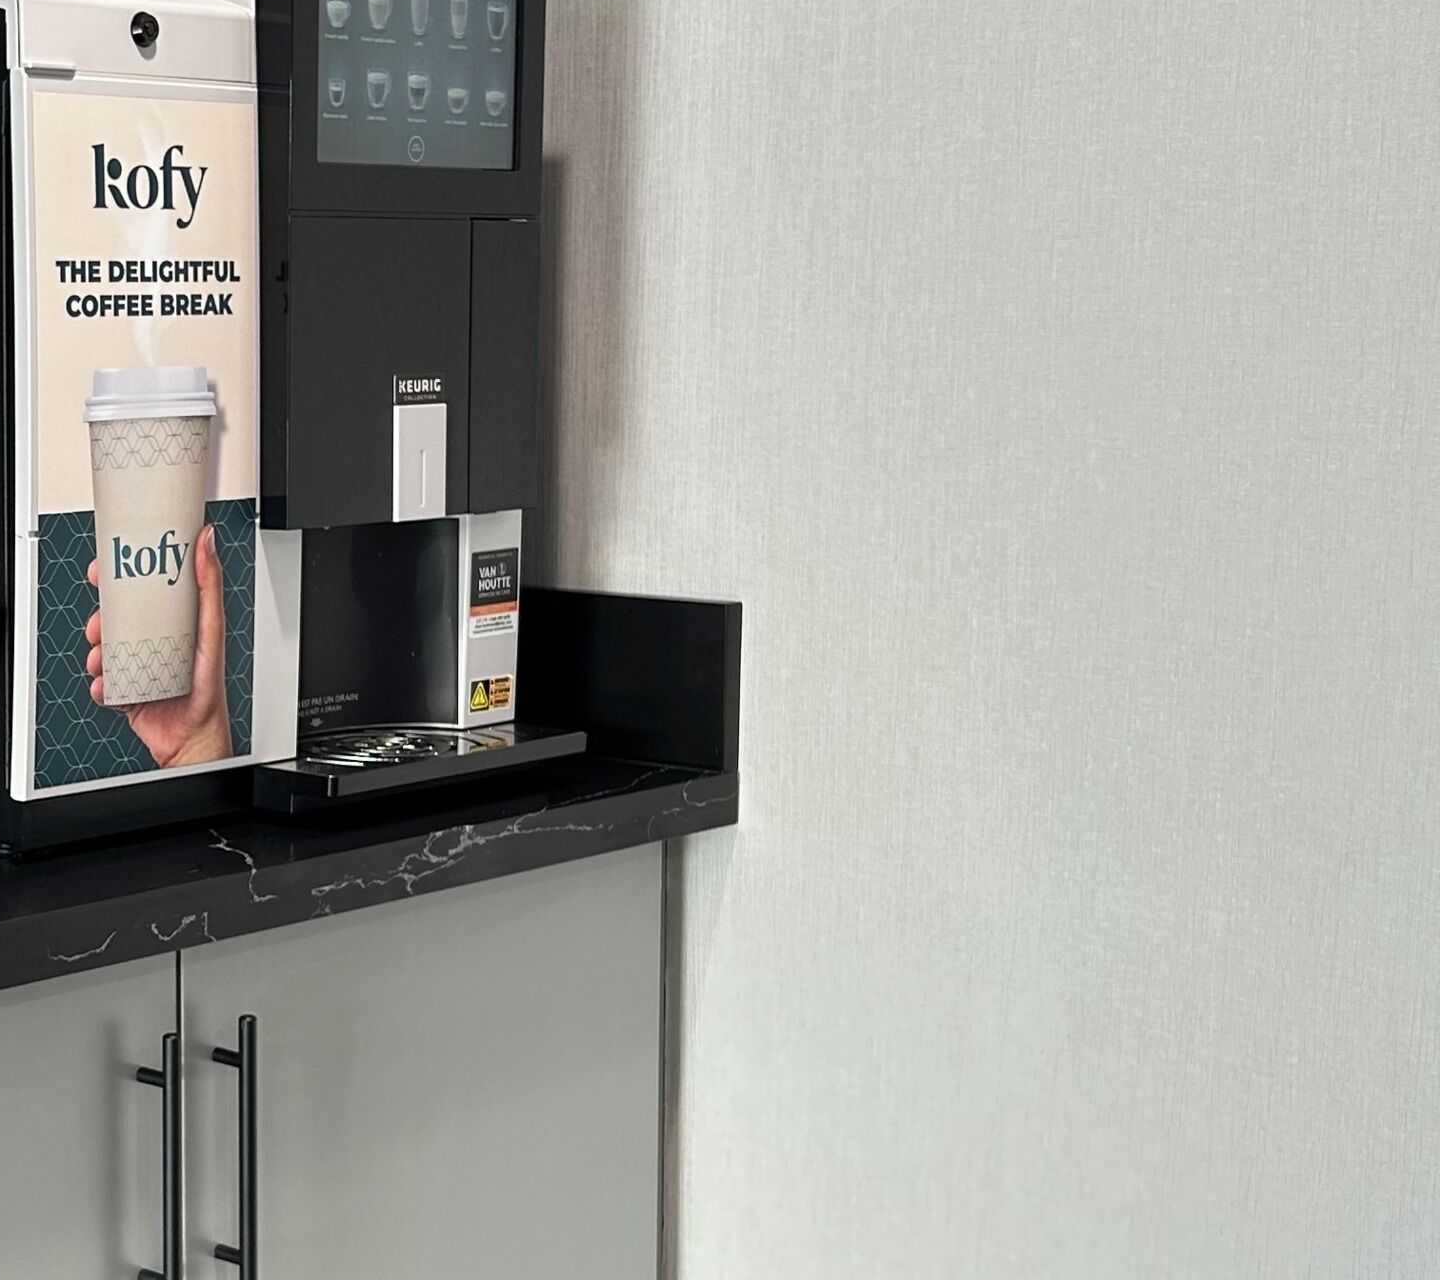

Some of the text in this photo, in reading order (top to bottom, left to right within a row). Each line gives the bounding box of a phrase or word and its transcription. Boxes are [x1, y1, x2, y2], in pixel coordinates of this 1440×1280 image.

[91, 143, 209, 229] kofy
[55, 260, 240, 283] THE DELIGHTFUL
[66, 293, 233, 318] COFFEE BREAK
[398, 378, 442, 393] KEURIG
[112, 530, 190, 586] kofy
[478, 565, 497, 579] VAN
[478, 576, 512, 591] HOUTTE
